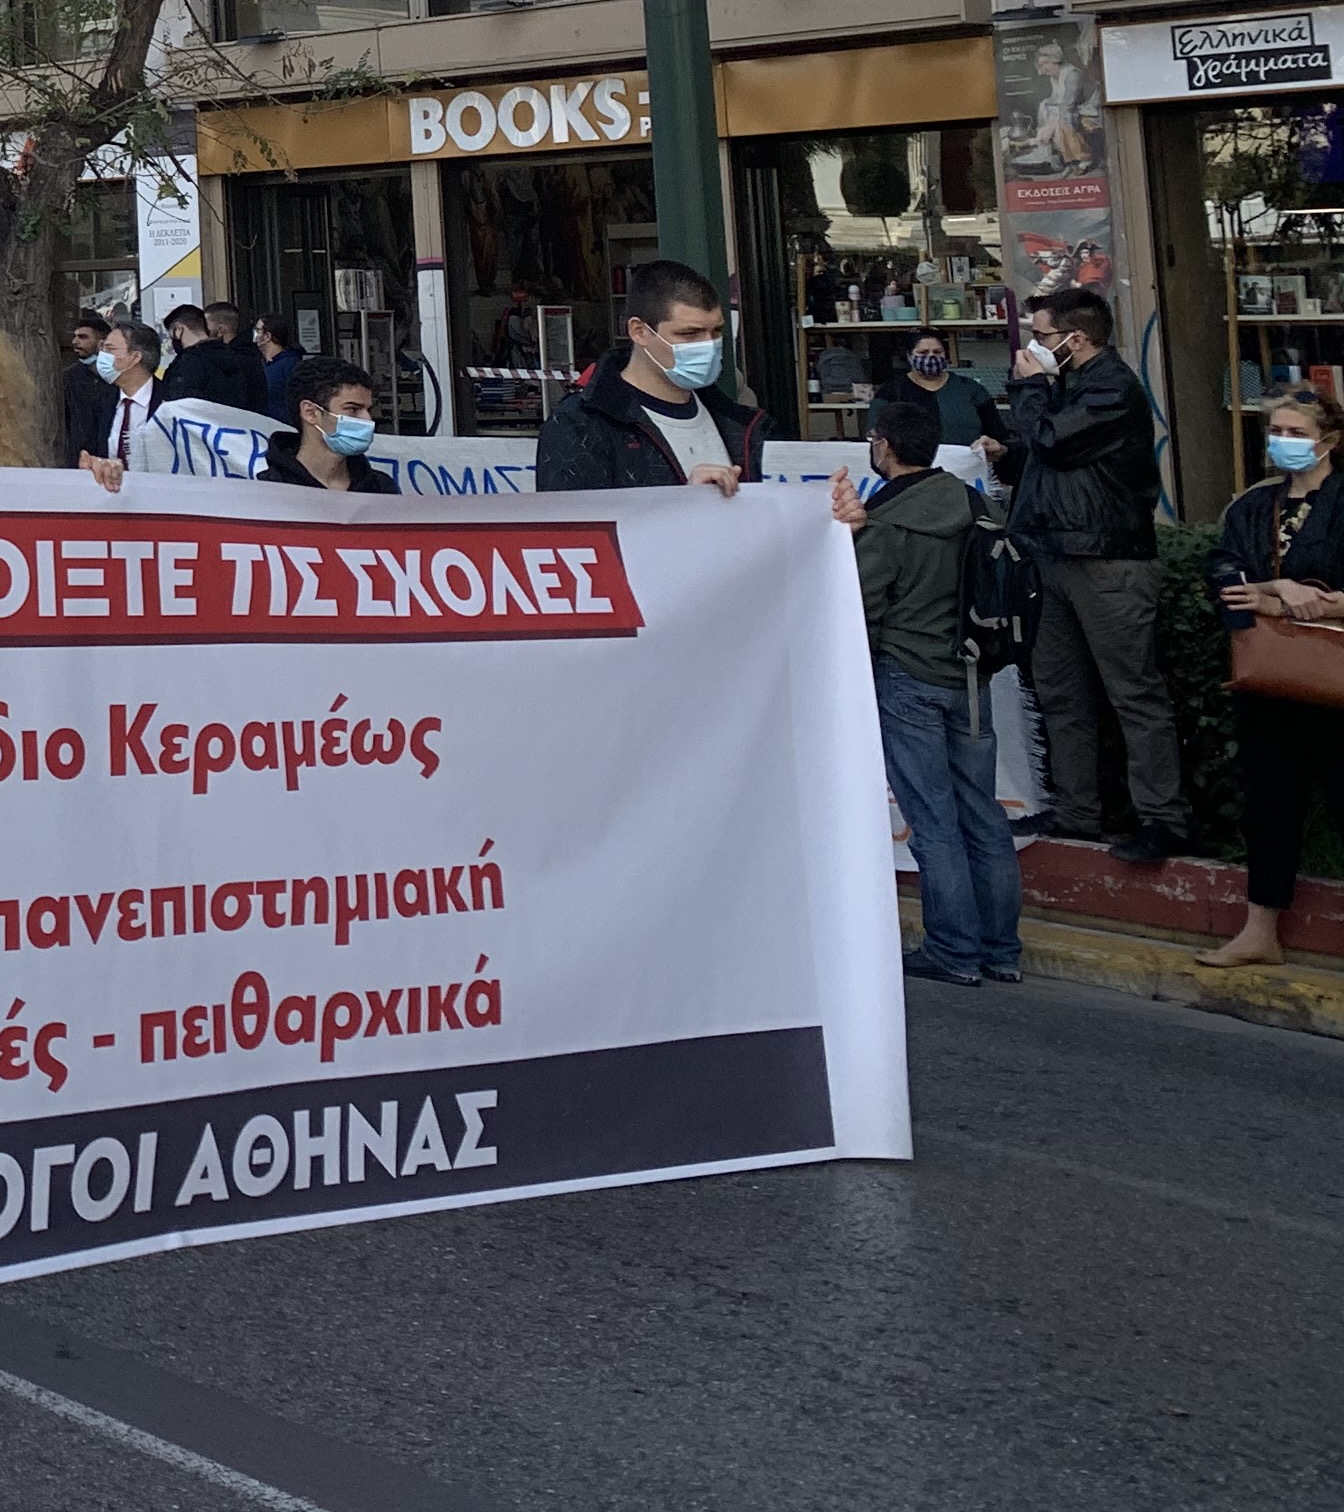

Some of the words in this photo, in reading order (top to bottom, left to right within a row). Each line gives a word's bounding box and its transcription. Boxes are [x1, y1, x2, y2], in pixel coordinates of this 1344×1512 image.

[1178, 20, 1307, 56] Ελληνικά
[1193, 52, 1329, 87] γράμματα
[408, 77, 631, 155] BOOKS
[222, 542, 346, 617] ΤΙΣ
[355, 546, 615, 617] ΣΧΟΛΕΣ
[110, 694, 443, 796] Κεραμέως
[139, 955, 502, 1064] πειθαρχικά
[174, 1089, 499, 1208] ΑΘΗΝΑΣ
